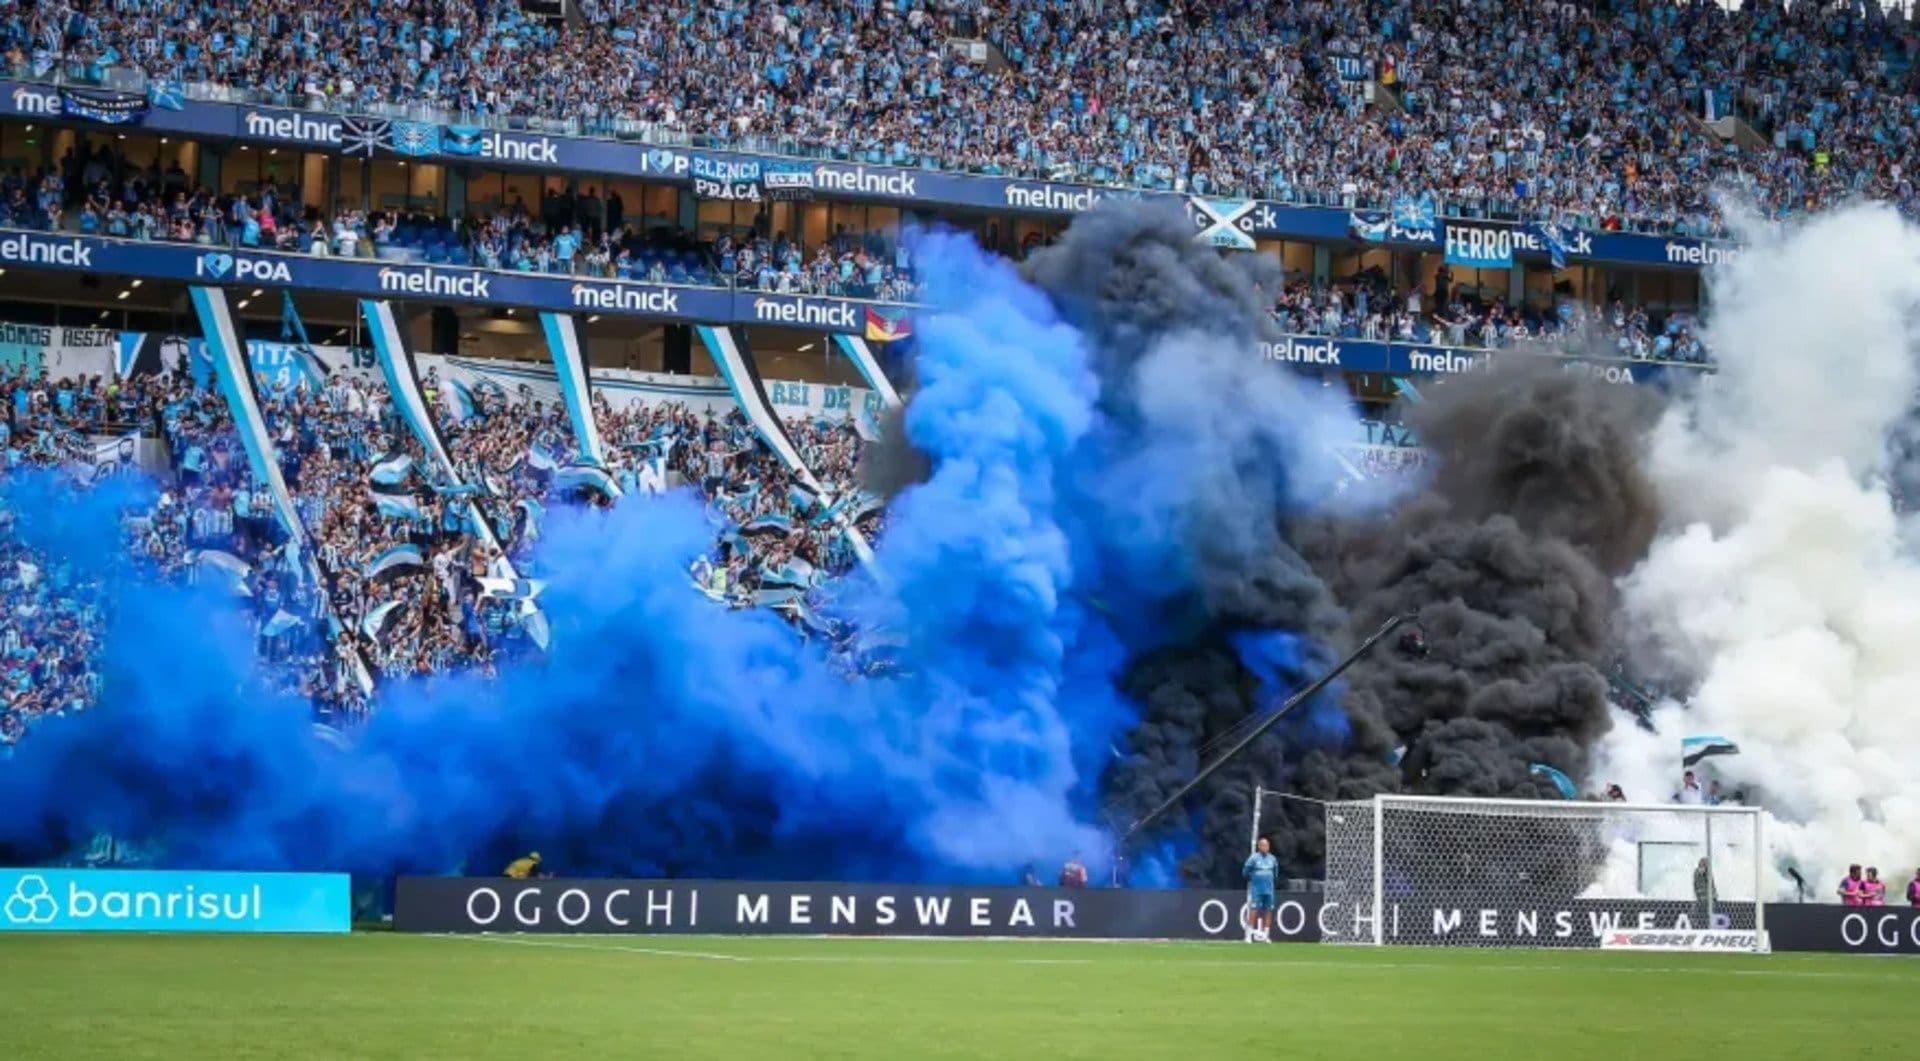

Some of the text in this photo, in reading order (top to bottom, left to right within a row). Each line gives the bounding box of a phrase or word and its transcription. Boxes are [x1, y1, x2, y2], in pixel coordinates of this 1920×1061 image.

[246, 111, 342, 142] melnic
[480, 136, 558, 164] elnick
[694, 156, 760, 179] ELENCO
[815, 166, 916, 197] melnick
[1006, 184, 1101, 211] melnick
[1445, 225, 1511, 260] FERRO
[1512, 230, 1592, 254] meck
[1665, 241, 1744, 264] melnic
[236, 260, 291, 281] POA
[380, 265, 489, 299] melnick
[572, 283, 678, 313] melnick
[754, 297, 856, 327] melnick
[1409, 350, 1491, 376] melni
[772, 384, 809, 407] REI
[824, 387, 850, 409] DE
[68, 882, 261, 919] banrisul
[466, 886, 1077, 929] OGOCHI MENSWEAR
